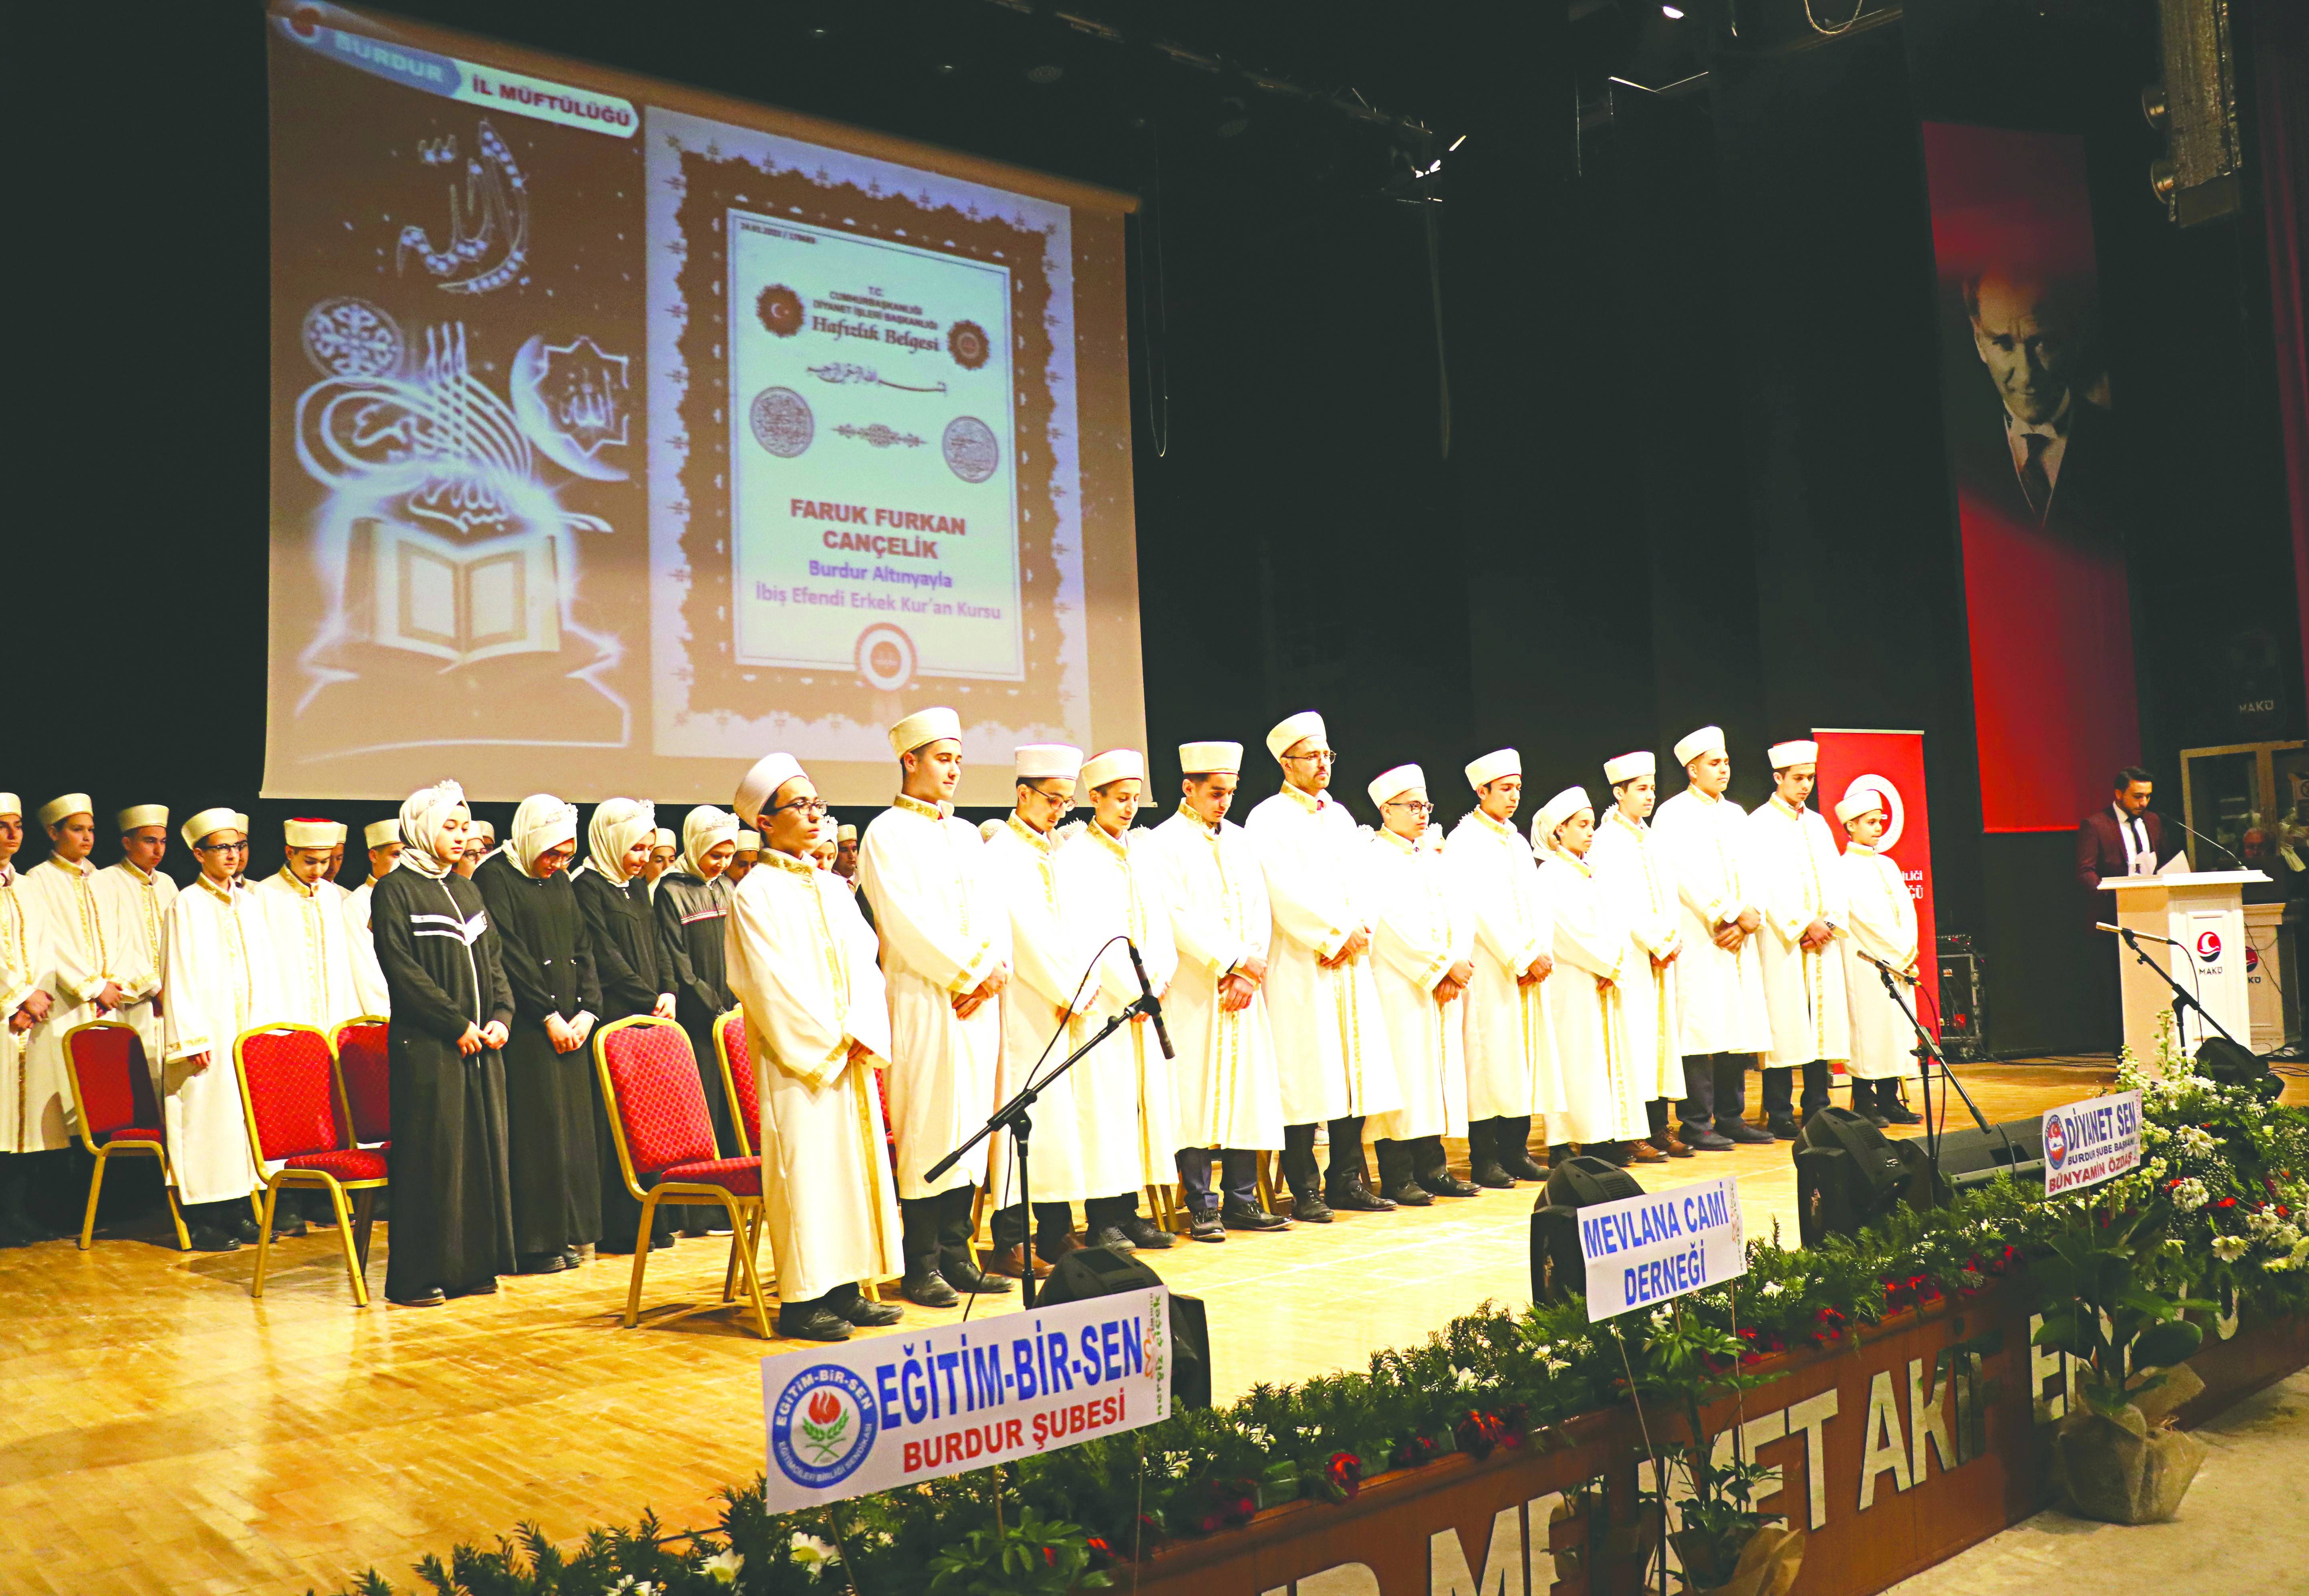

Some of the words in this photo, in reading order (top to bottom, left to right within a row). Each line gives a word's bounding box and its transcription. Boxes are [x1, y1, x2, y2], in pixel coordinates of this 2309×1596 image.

[334, 29, 444, 83] BURDUR
[473, 75, 493, 96] İL
[499, 83, 631, 127] MÜFTÜLÜĞÜ
[884, 328, 940, 354] Belgesi
[790, 498, 868, 525] FARUK
[874, 508, 967, 536] FURKAN
[822, 530, 939, 559] CANÇELİK
[808, 560, 868, 580] Burdur
[872, 565, 953, 590] Altınyayla
[756, 581, 787, 607] İbiş
[792, 586, 845, 608] Efendi
[850, 592, 896, 612] Erkek
[900, 597, 953, 617] Kur'an
[956, 601, 1001, 620] Kursu
[2199, 967, 2222, 975] MAKÜ
[2247, 976, 2261, 984] KÜ
[2065, 1107, 2114, 1152] DİYANET
[2116, 1101, 2136, 1137] SEN
[2068, 1150, 2096, 1165] BURDUR
[2049, 1161, 2106, 1193] BÜNYAMİN
[1583, 1201, 1682, 1259] MEVLANA
[1684, 1181, 1729, 1233] CAMİ
[1624, 1239, 1707, 1306] DERNEĞİ
[876, 1316, 1144, 1431] EĞİTİM-BİR-SEN
[903, 1419, 1023, 1473] BURDUR
[1031, 1387, 1126, 1450] ŞUBESİ
